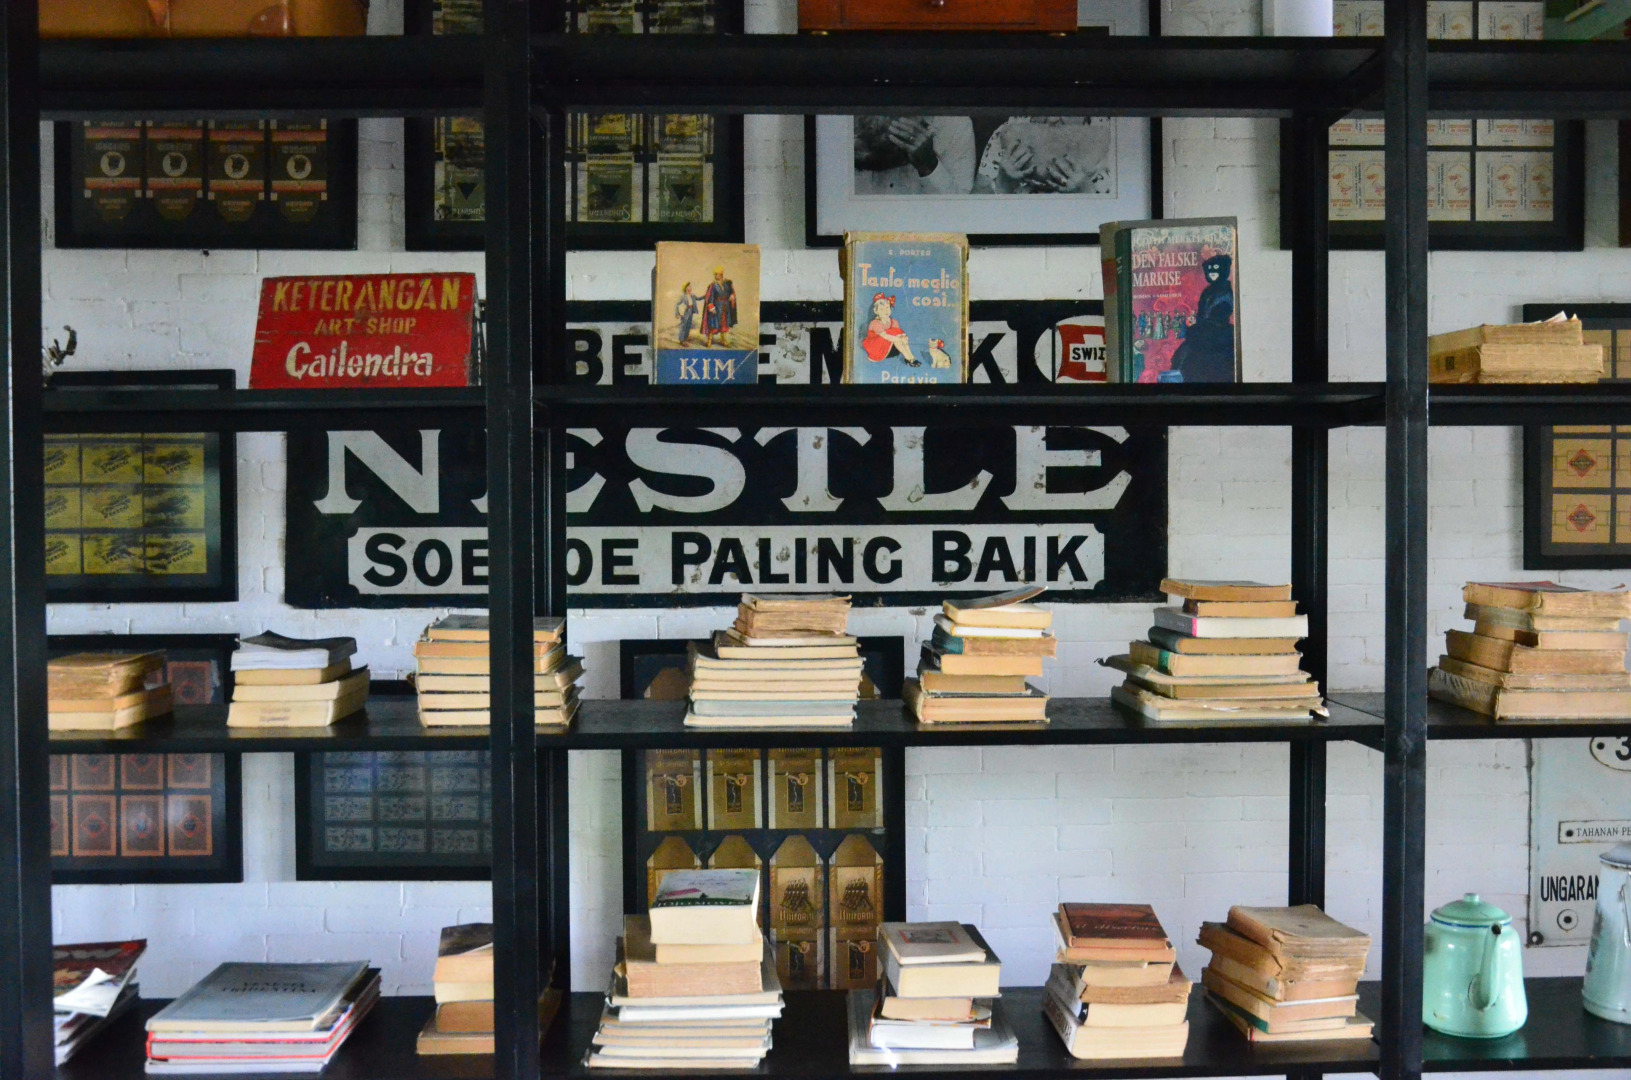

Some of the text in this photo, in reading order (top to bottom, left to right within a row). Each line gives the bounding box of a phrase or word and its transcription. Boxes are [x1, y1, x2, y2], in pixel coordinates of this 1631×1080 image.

[1132, 253, 1157, 269] DEN
[1158, 251, 1199, 267] FALSKE
[858, 263, 960, 293] Tanto meglio
[1132, 270, 1182, 287] MARKISE
[272, 278, 461, 312] KETERANGAN
[313, 316, 417, 336] ART SHOP
[285, 341, 433, 380] Cailendra
[679, 357, 736, 381] KIM
[881, 370, 938, 384] Paravia
[363, 530, 1089, 587] SOEOE PALING BAIK
[1576, 827, 1619, 837] TAHANAN
